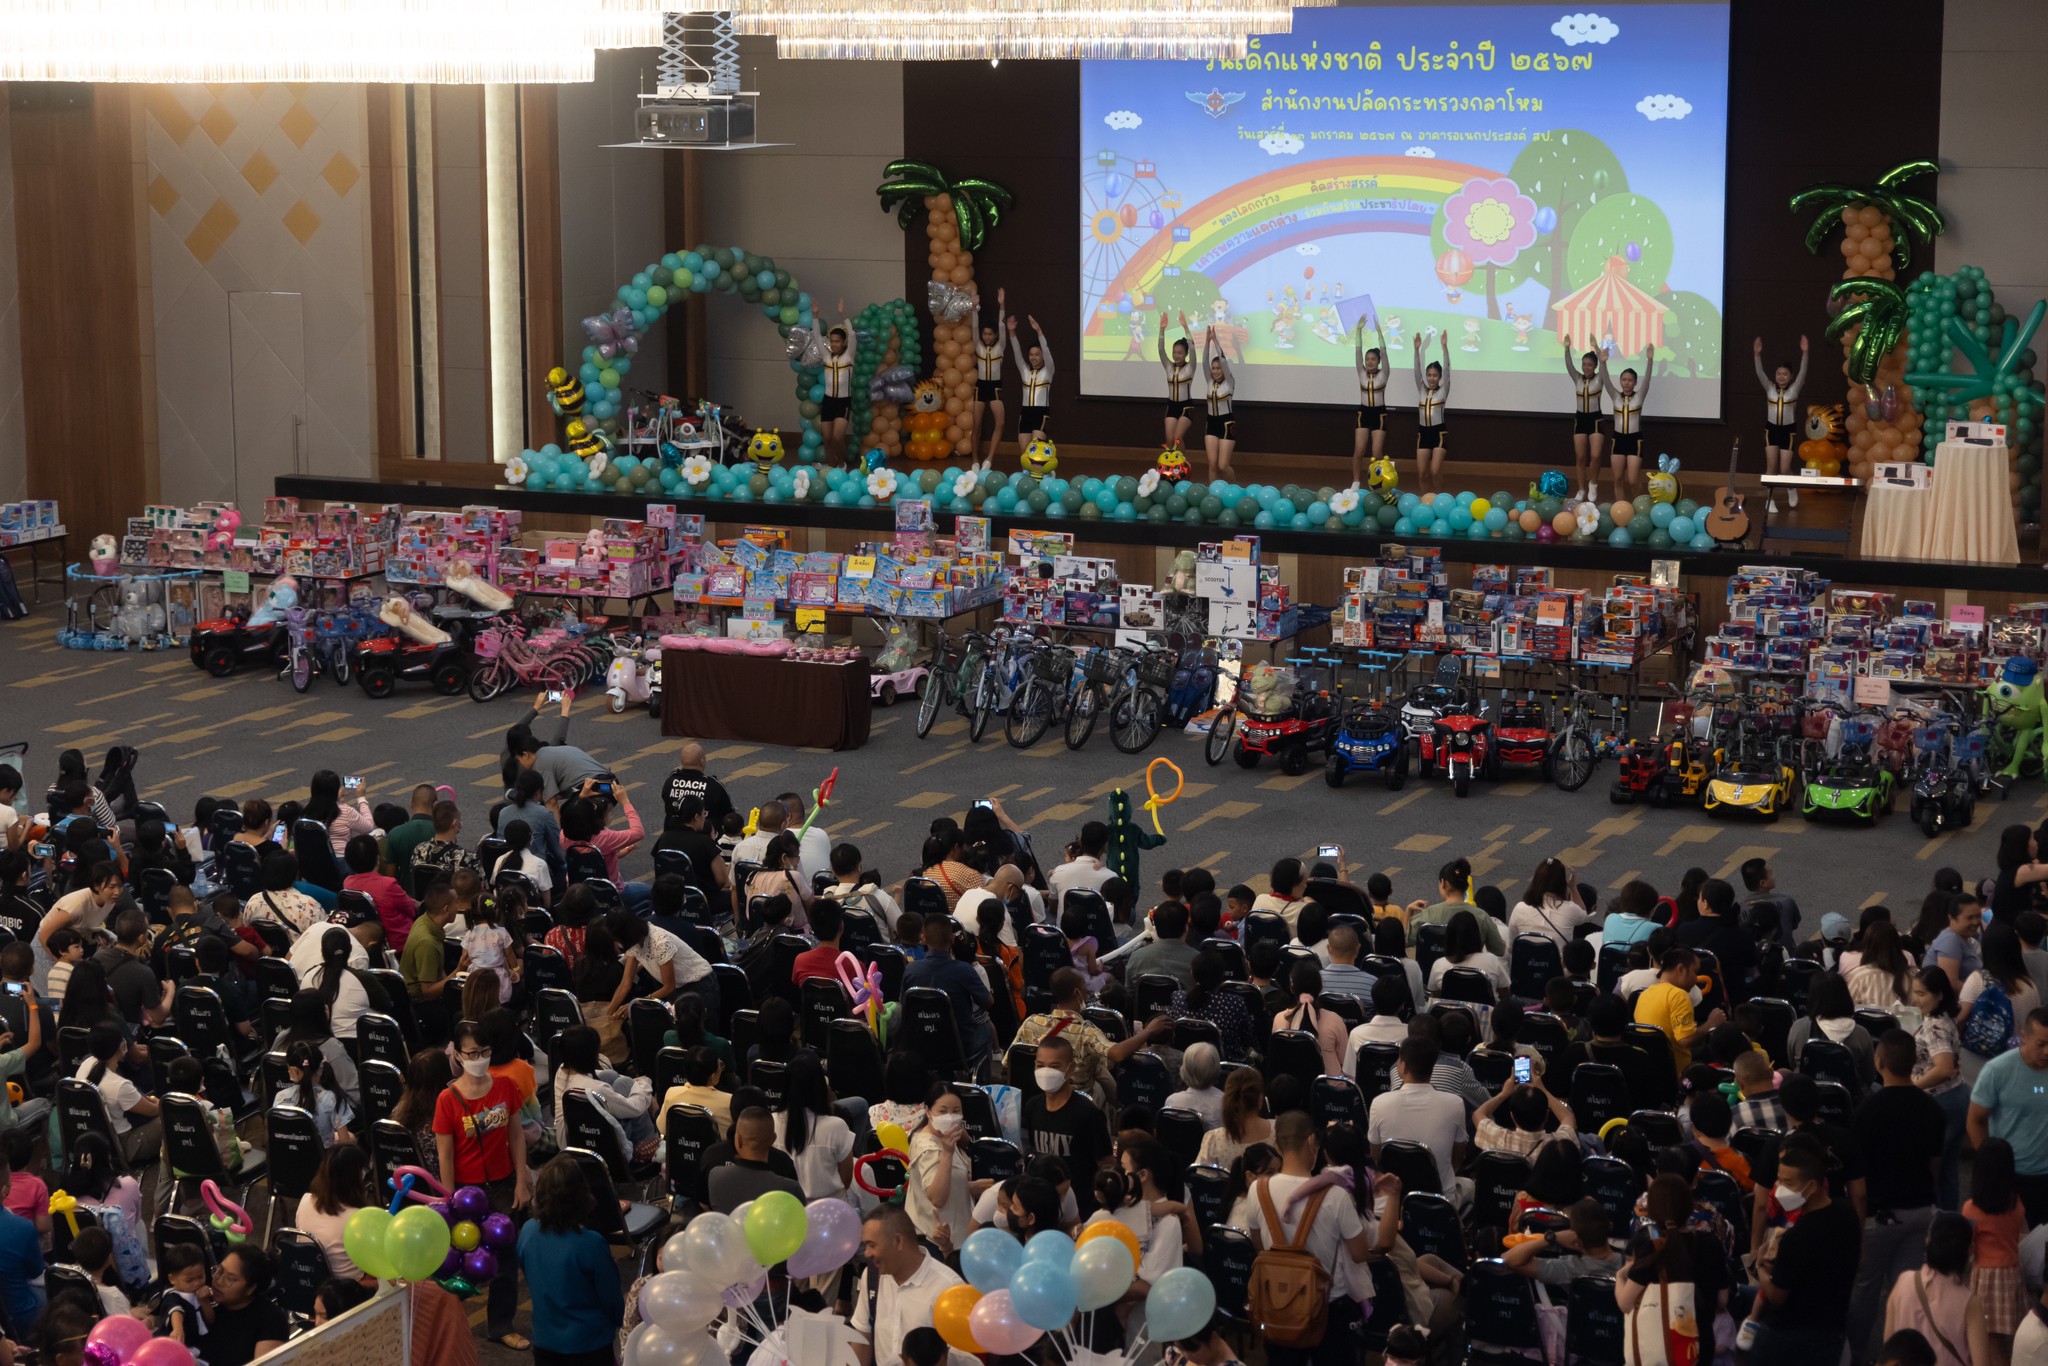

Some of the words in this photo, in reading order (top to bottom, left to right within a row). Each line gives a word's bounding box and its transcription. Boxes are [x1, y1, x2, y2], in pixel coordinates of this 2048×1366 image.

[1396, 40, 1495, 71] ประจำปี
[1511, 52, 1593, 71] ๒๕๖๗
[1262, 88, 1543, 112] สำนักงานปลัดกระทรวงกลาโหม
[1310, 130, 1354, 140] มกราคม
[672, 778, 708, 791] COACH
